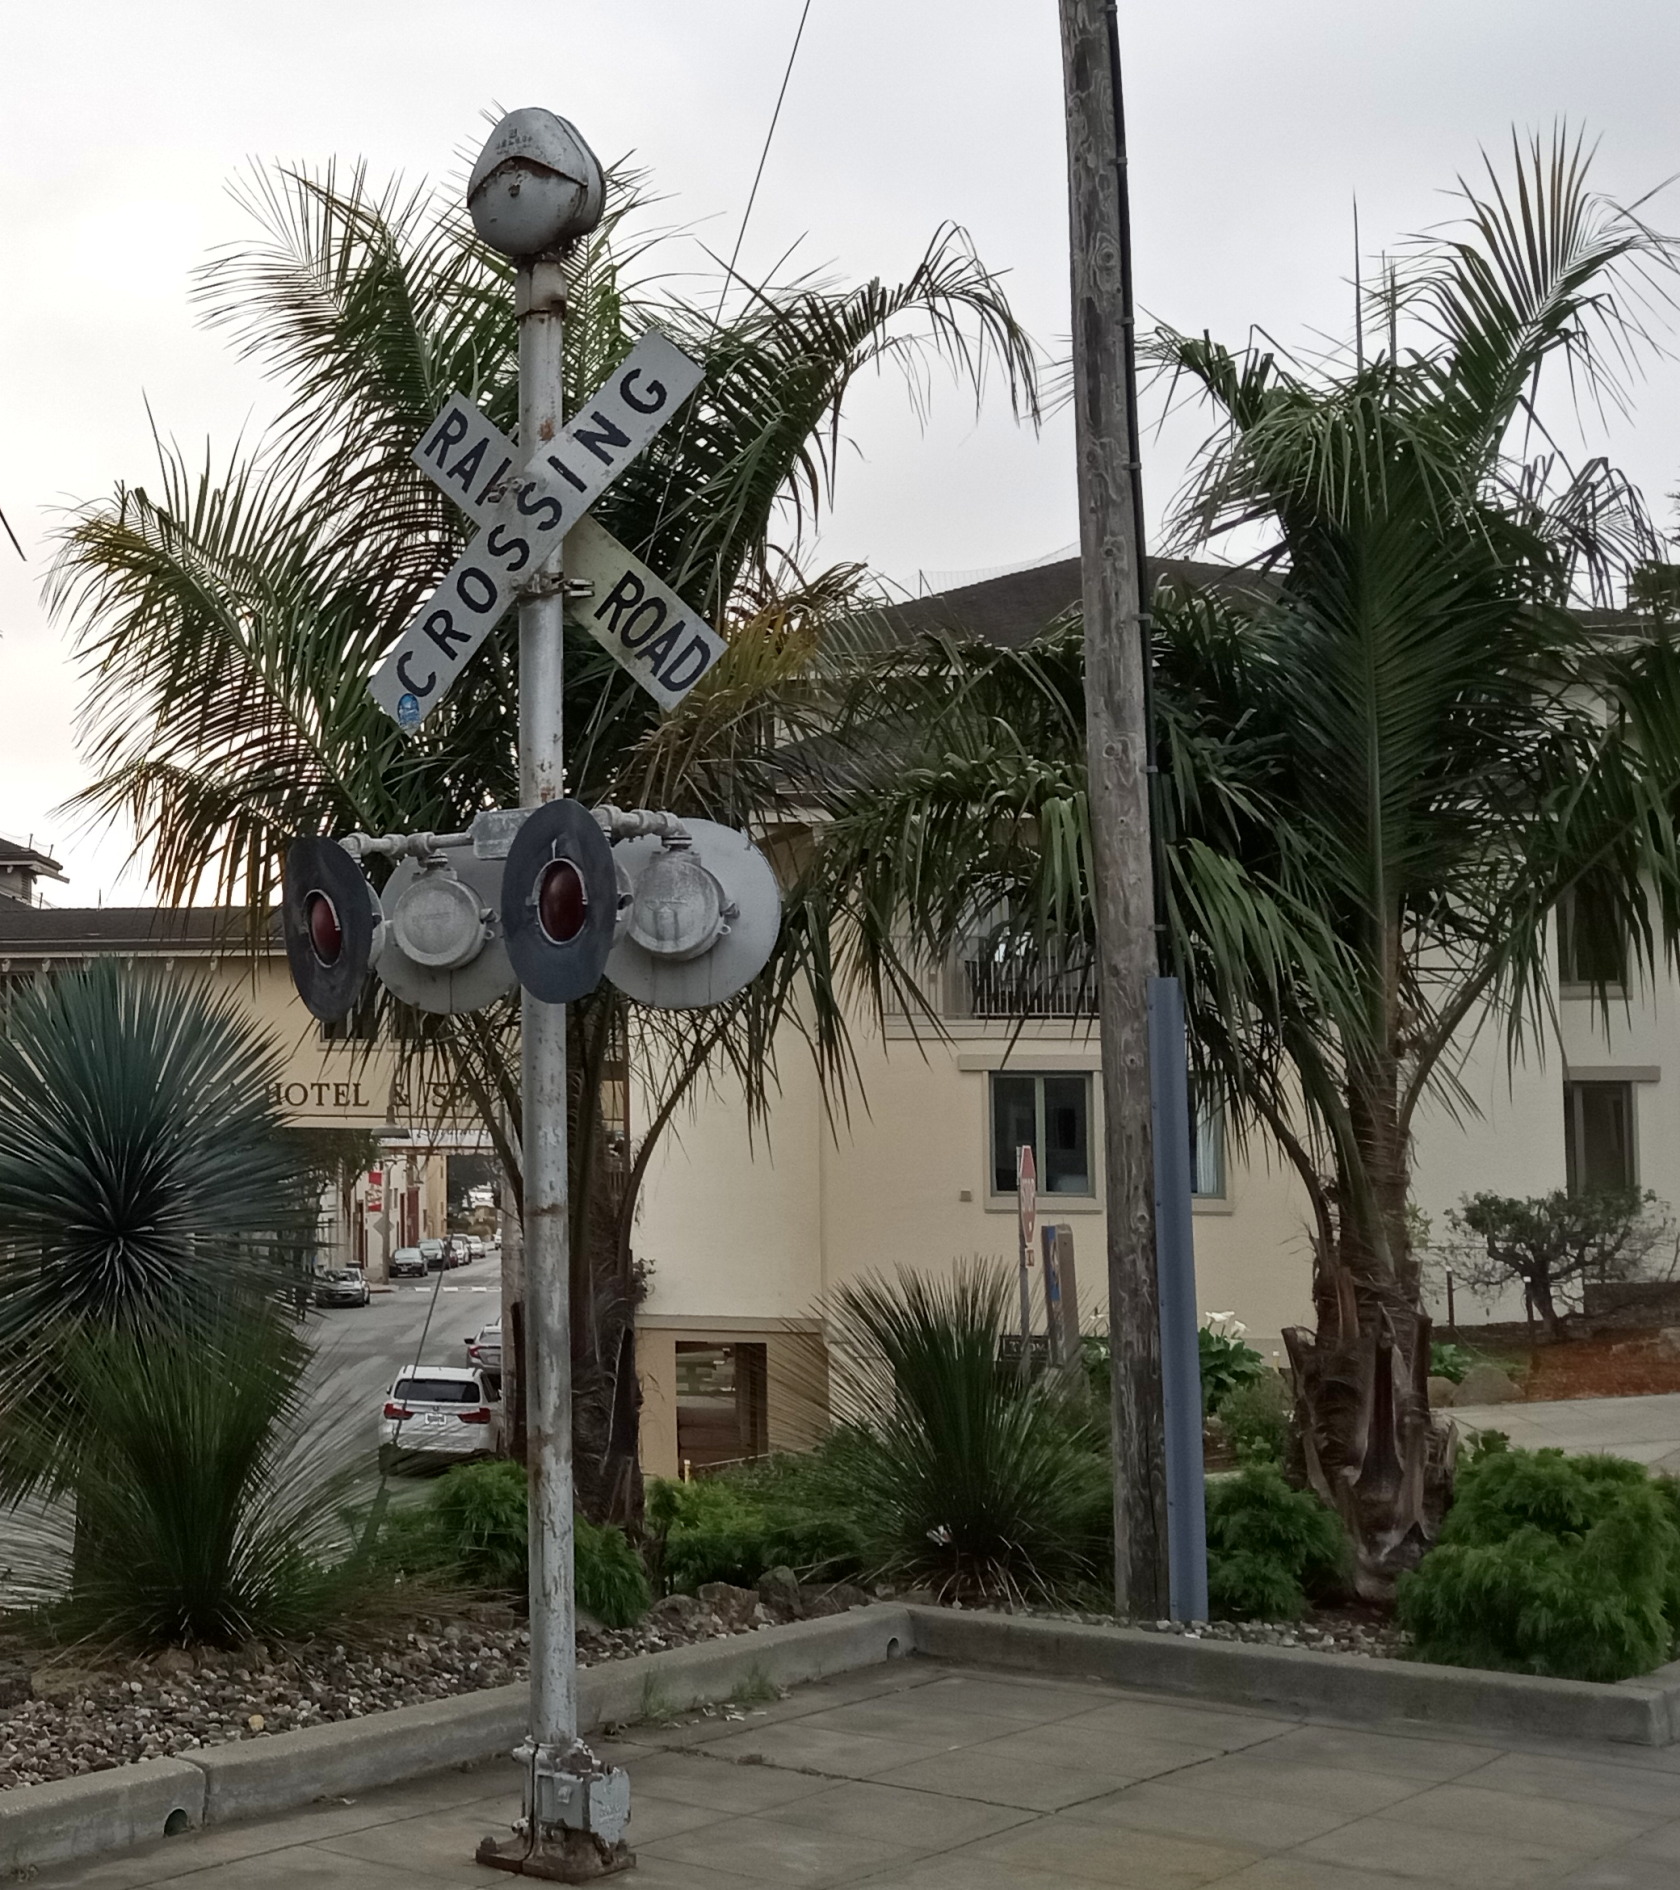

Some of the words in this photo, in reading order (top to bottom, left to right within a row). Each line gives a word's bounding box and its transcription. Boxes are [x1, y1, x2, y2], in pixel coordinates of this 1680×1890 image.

[424, 407, 512, 506] RAI
[396, 368, 667, 697] CROSSING
[593, 570, 711, 692] ROAD
[264, 1082, 370, 1107] HOTEL
